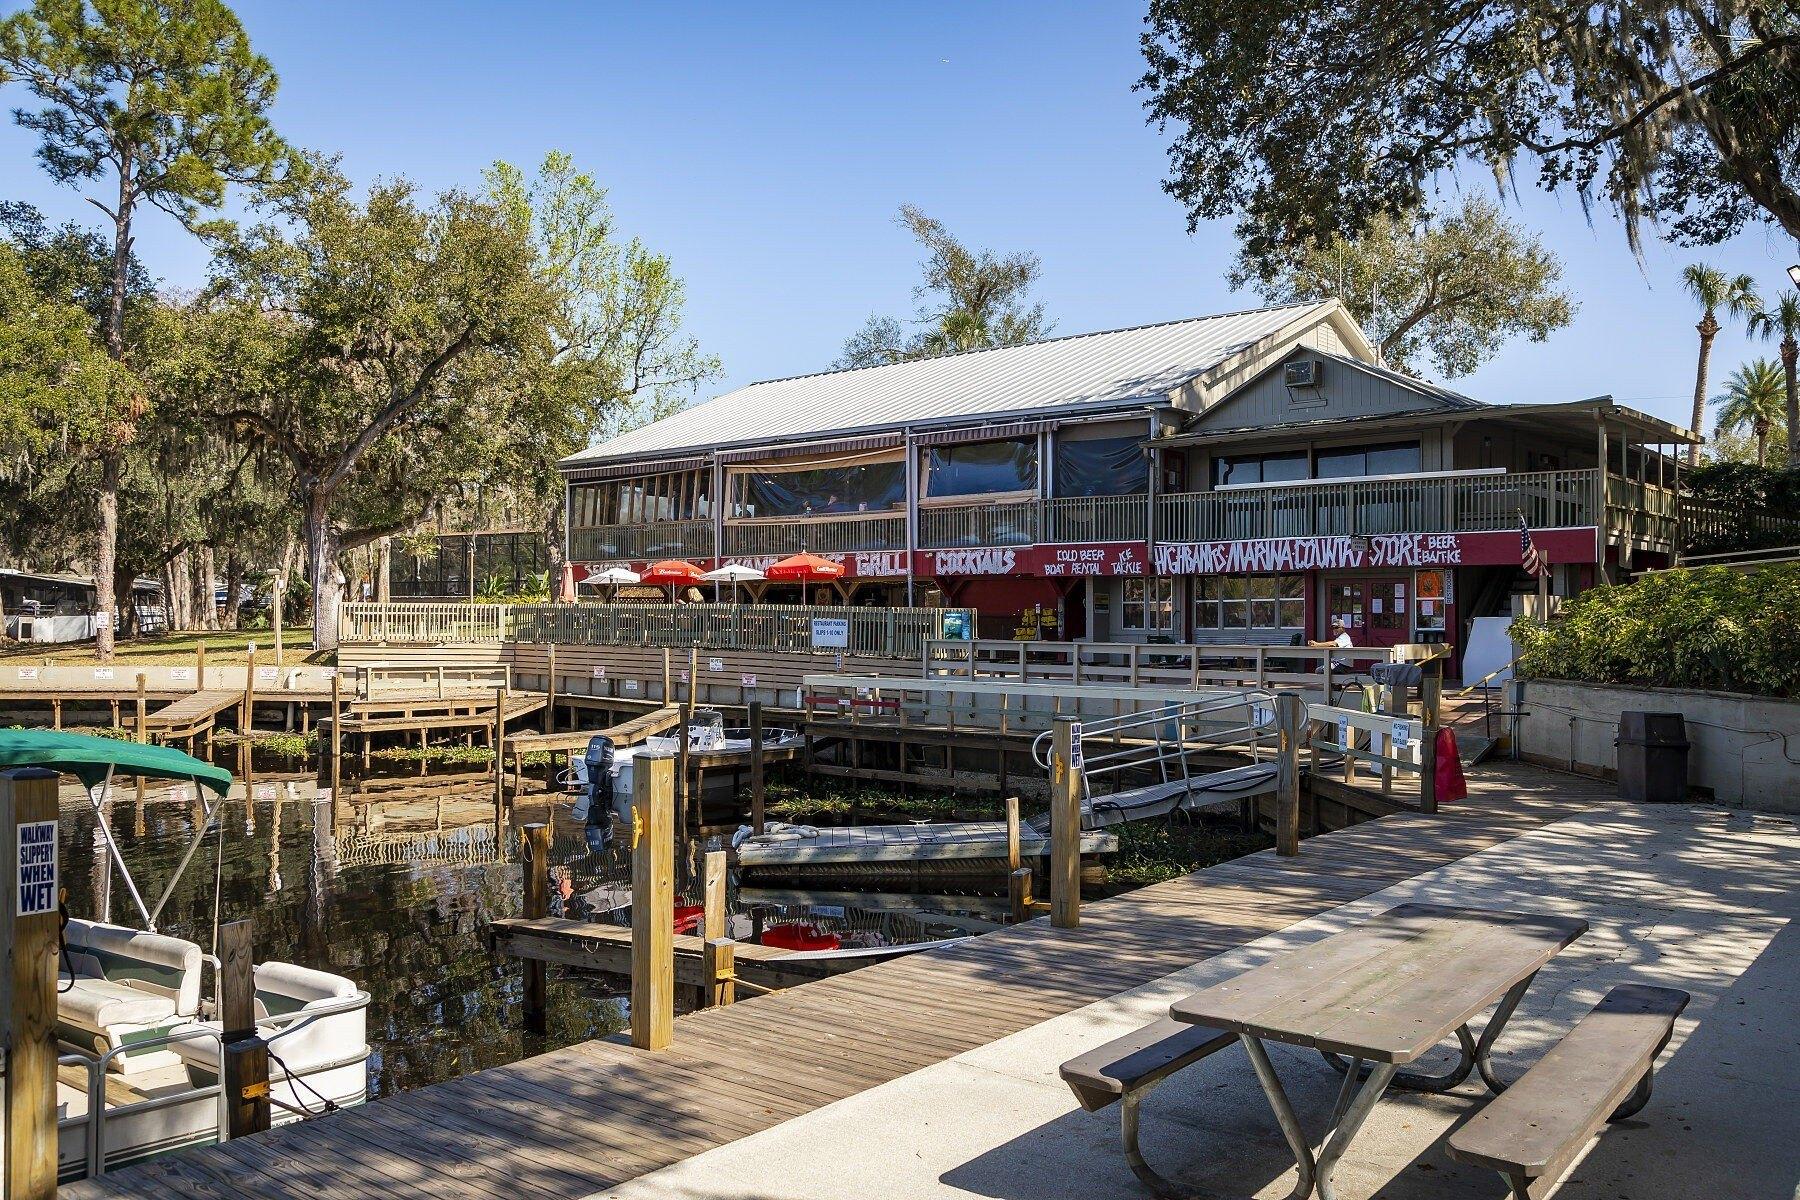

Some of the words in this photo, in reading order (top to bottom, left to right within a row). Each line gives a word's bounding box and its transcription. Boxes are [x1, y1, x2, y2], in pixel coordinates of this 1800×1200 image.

[1428, 535, 1457, 549] BEER
[935, 548, 1016, 575] COCKTAILS
[1056, 550, 1078, 561] COLD
[1080, 549, 1105, 561] BEER
[1119, 548, 1133, 564] ICE
[1226, 540, 1293, 572] MARINA
[1369, 535, 1423, 566] STORE
[856, 552, 908, 577] GRILL
[1044, 563, 1065, 576] BOAT
[1070, 562, 1103, 576] RENTAL
[1110, 562, 1142, 575] TACKLE
[20, 825, 54, 844] WALKWAY
[20, 843, 54, 865] SLIPPERY
[20, 863, 54, 883] WHEN
[20, 882, 54, 912] WET
